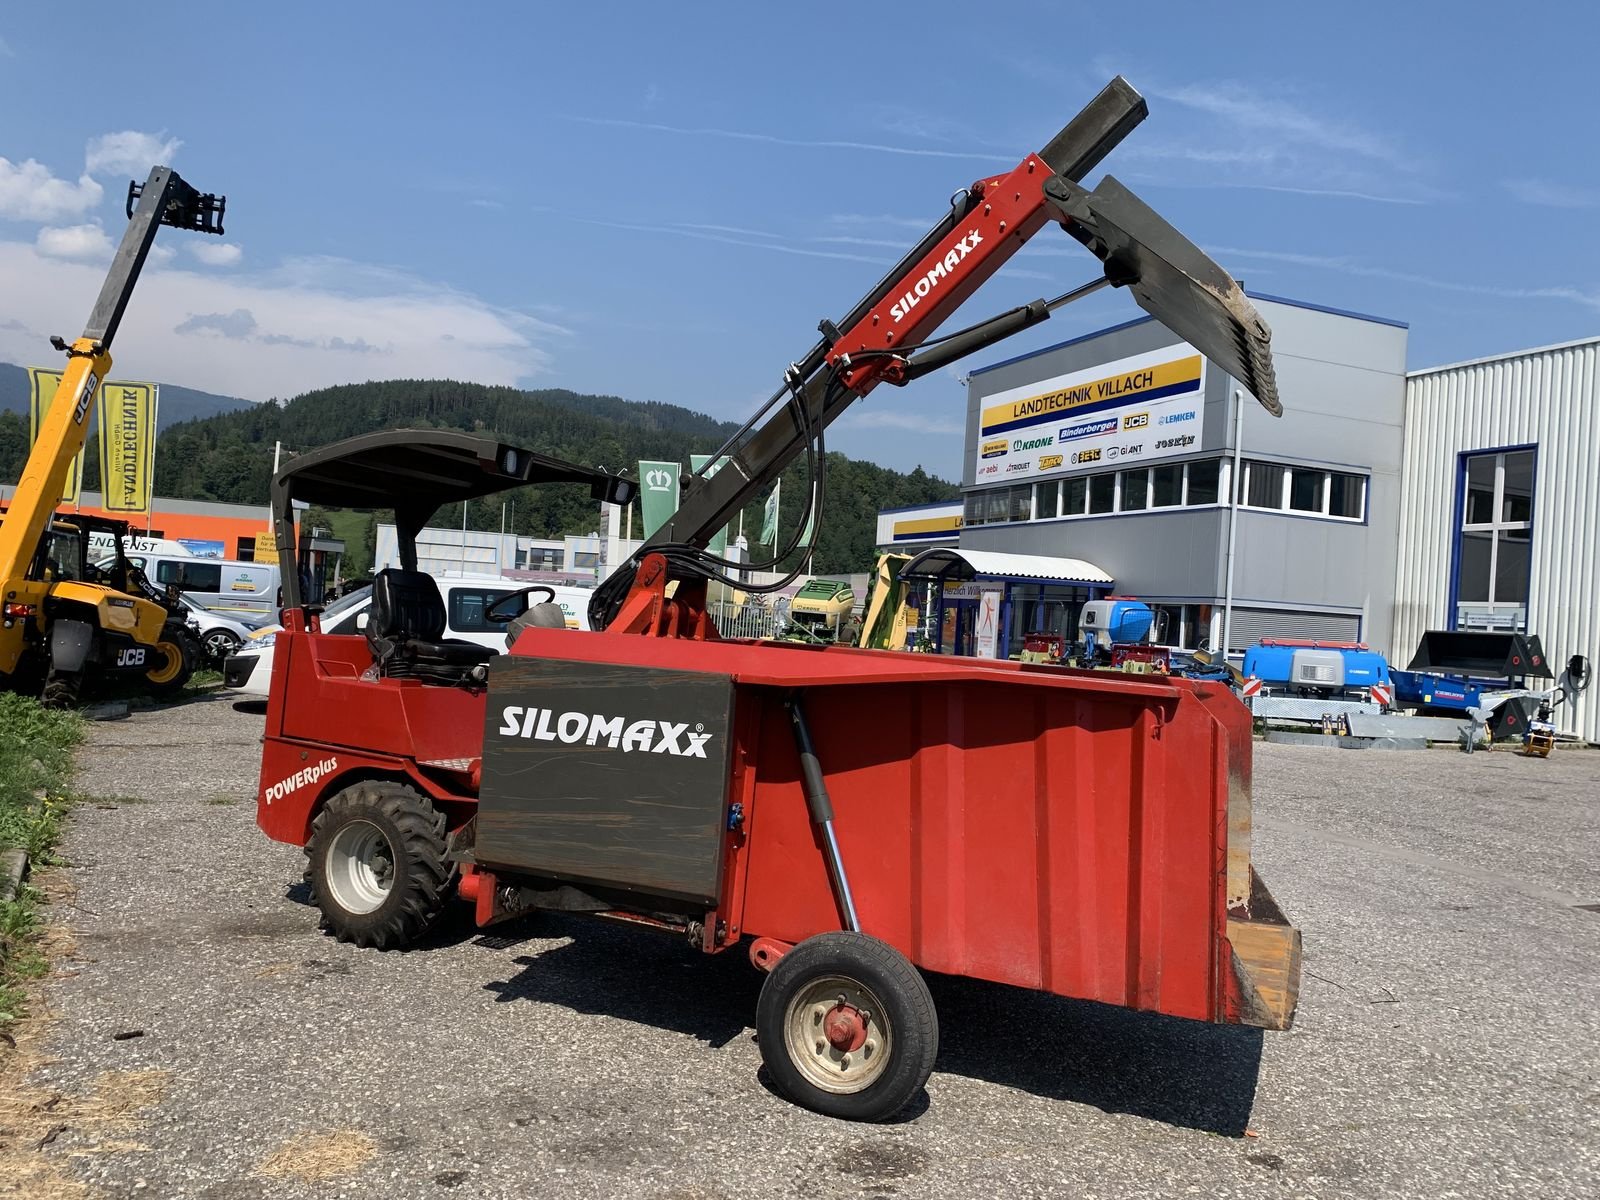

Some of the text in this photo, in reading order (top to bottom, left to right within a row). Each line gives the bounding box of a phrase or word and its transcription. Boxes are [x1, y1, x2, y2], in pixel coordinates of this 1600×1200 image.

[74, 371, 98, 425] JCB
[1013, 371, 1153, 418] LANDTECHNIK VILLACH
[1124, 415, 1148, 428] JCB
[1165, 411, 1196, 424] LEMKEN
[1060, 420, 1117, 438] Binderberger
[1022, 436, 1054, 451] KRONE
[1155, 435, 1196, 450] JOSKIN
[986, 464, 999, 474] aebi
[139, 581, 155, 596] JCB
[117, 648, 146, 666] JCB
[265, 756, 338, 806] POWERplus
